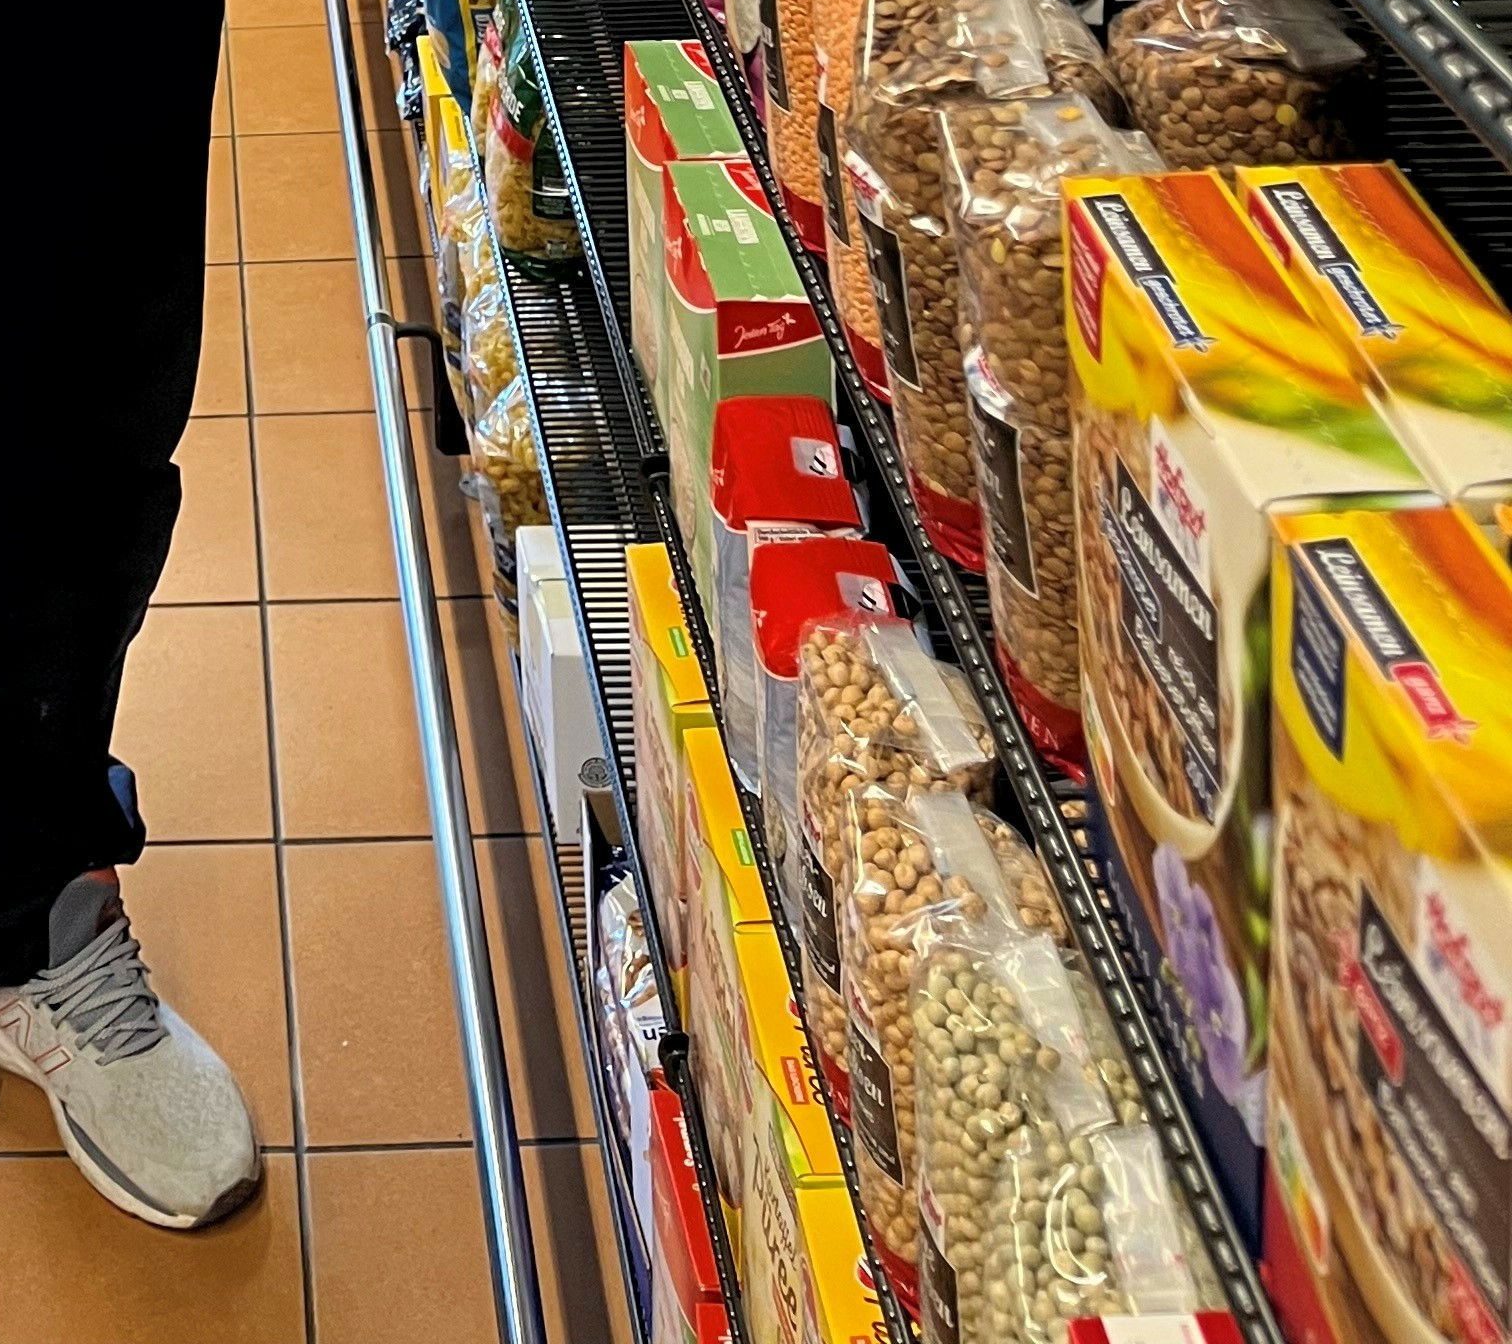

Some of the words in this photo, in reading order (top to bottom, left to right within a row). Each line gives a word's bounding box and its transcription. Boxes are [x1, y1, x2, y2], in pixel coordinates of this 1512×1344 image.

[1094, 199, 1154, 272] Leinsamen
[1272, 188, 1337, 262] Leinsamen
[1315, 548, 1406, 656] Leinsamen
